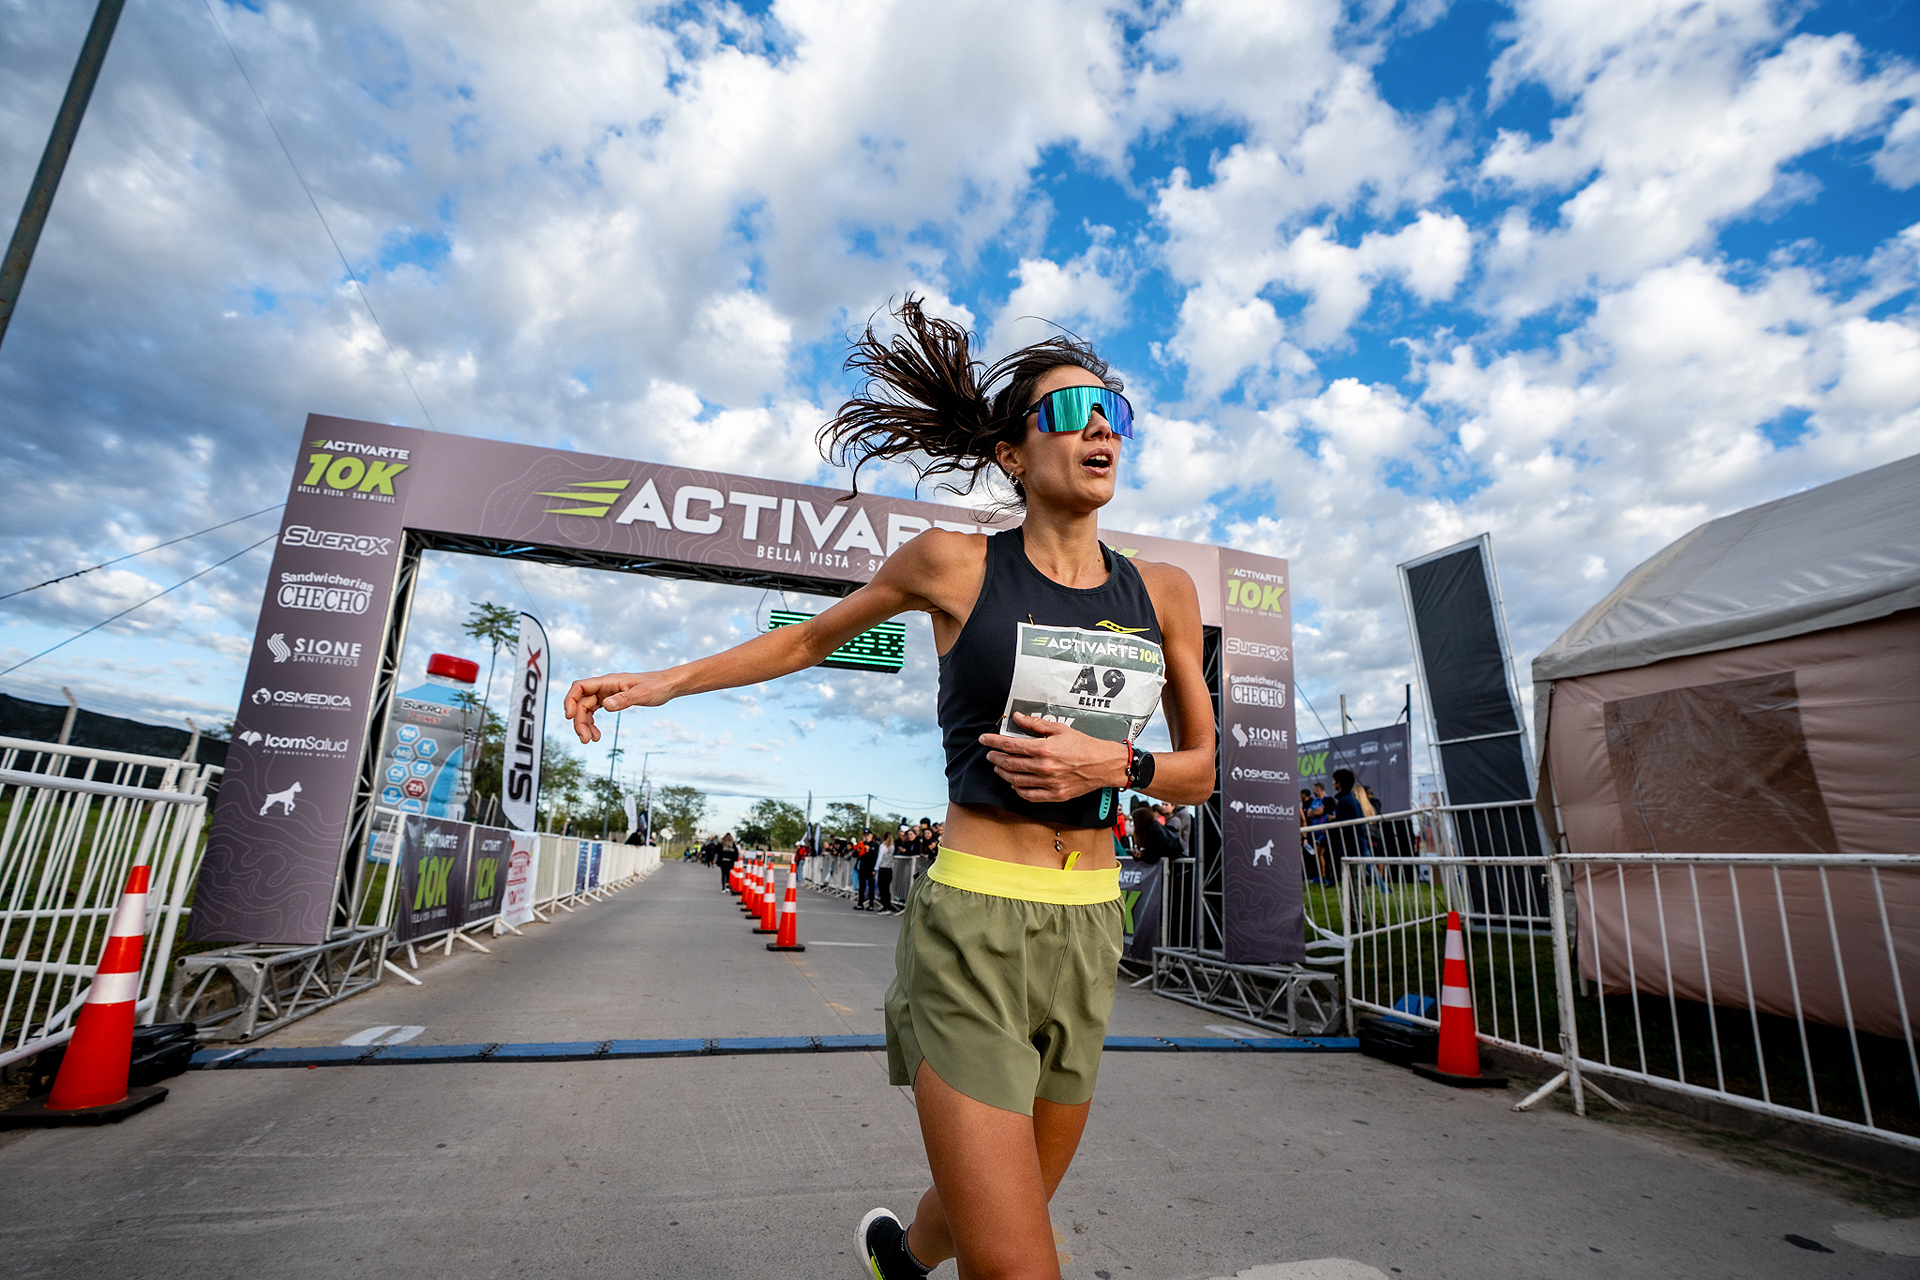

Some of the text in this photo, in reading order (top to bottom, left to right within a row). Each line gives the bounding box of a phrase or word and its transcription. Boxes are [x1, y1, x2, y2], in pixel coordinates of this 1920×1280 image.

[323, 440, 411, 460] ACTIVARTE
[303, 453, 409, 495] 10K
[297, 485, 396, 504] BELLA VISTA SAN MIGUEL
[616, 477, 997, 558] ACTIVAR
[757, 545, 884, 572] BELLA VISTA SA
[1233, 568, 1285, 584] ACTIVARTE
[277, 583, 371, 615] CHECHO
[1227, 579, 1286, 613] 10K
[294, 637, 362, 657] SIONE
[1047, 636, 1160, 665] ACTIVARTE 10K
[292, 654, 359, 668] SANITARIOS
[1069, 665, 1126, 699] A9
[273, 690, 352, 707] OSMEDICA
[1078, 697, 1111, 709] ELITE
[1231, 684, 1286, 708] CHECHO
[264, 733, 349, 752] IcomSalud
[1248, 727, 1288, 742] SIONE
[1249, 740, 1288, 750] SANITARIOS
[1243, 768, 1290, 780] OSMEDICA
[1245, 802, 1294, 816] IcomSalud
[413, 856, 455, 911] 10K
